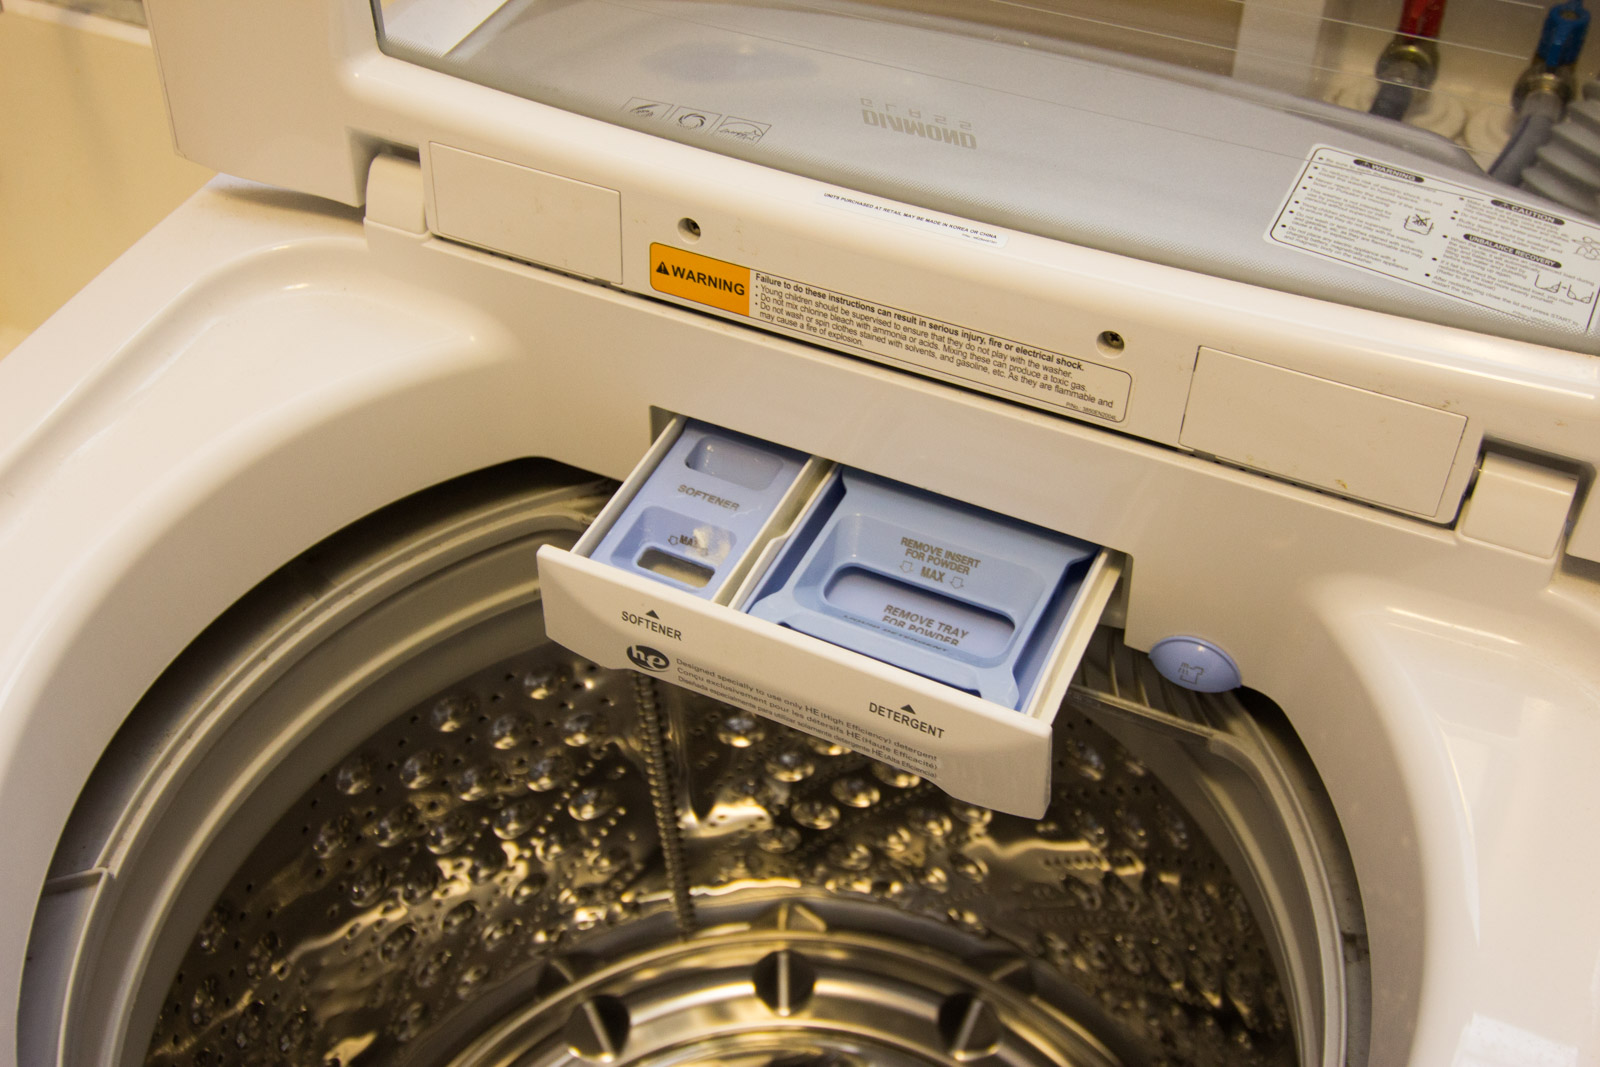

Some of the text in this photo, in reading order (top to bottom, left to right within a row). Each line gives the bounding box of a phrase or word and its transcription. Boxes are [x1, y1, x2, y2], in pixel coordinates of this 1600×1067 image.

[1369, 162, 1417, 182] WARNING
[840, 196, 874, 208] PURCHASED
[882, 207, 901, 215] RETAIL
[948, 223, 968, 232] KOREA
[979, 231, 997, 239] CHINA
[1509, 204, 1557, 224] CAUTION
[1466, 234, 1515, 254] UNBALANCE
[1512, 248, 1557, 267] RECOVERY
[671, 264, 746, 297] WARNING
[755, 272, 1084, 371] Failure to do these instructions can result in serious injury, fire or electrical shock.
[759, 311, 774, 322] may
[776, 316, 798, 327] cause
[805, 322, 817, 333] fire
[818, 327, 826, 335] of
[827, 330, 863, 346] explosion.
[760, 283, 1072, 378] Young children should be supervised to ensure that they do not play with the washer.
[759, 300, 1113, 408] Do not wash or spin clothes stained with solvents, and gasoline, etc. As they are flammable and
[760, 292, 771, 303] Do
[772, 297, 784, 306] not
[785, 301, 798, 310] mix
[799, 304, 828, 319] chlorine
[829, 312, 854, 326] bleach
[855, 321, 871, 330] with
[872, 325, 907, 341] ammonia
[917, 338, 940, 350] acids.
[942, 343, 968, 359] Mixing
[969, 352, 991, 364] these
[992, 359, 1007, 368] can
[1008, 364, 1041, 379] produce
[1042, 373, 1048, 381] a
[1050, 374, 1069, 387] toxic
[1070, 381, 1086, 391] gas.
[677, 484, 740, 512] SOFTENER
[900, 536, 982, 569] REMOVE INSERT
[904, 548, 971, 576] FOR POWDER
[919, 566, 946, 583] MAX
[621, 610, 682, 642] SOFTENER
[881, 615, 907, 629] FOR
[907, 623, 960, 647] POWDER
[883, 604, 935, 629] REMOVE
[937, 621, 970, 640] TRAY
[675, 657, 937, 761] Designed specially to use only HE (High Efficiency) detergent
[676, 666, 937, 770] Conçu exclusivement pour les détersifs HE (Haute Efficacité)
[868, 701, 945, 739] DETERGENT
